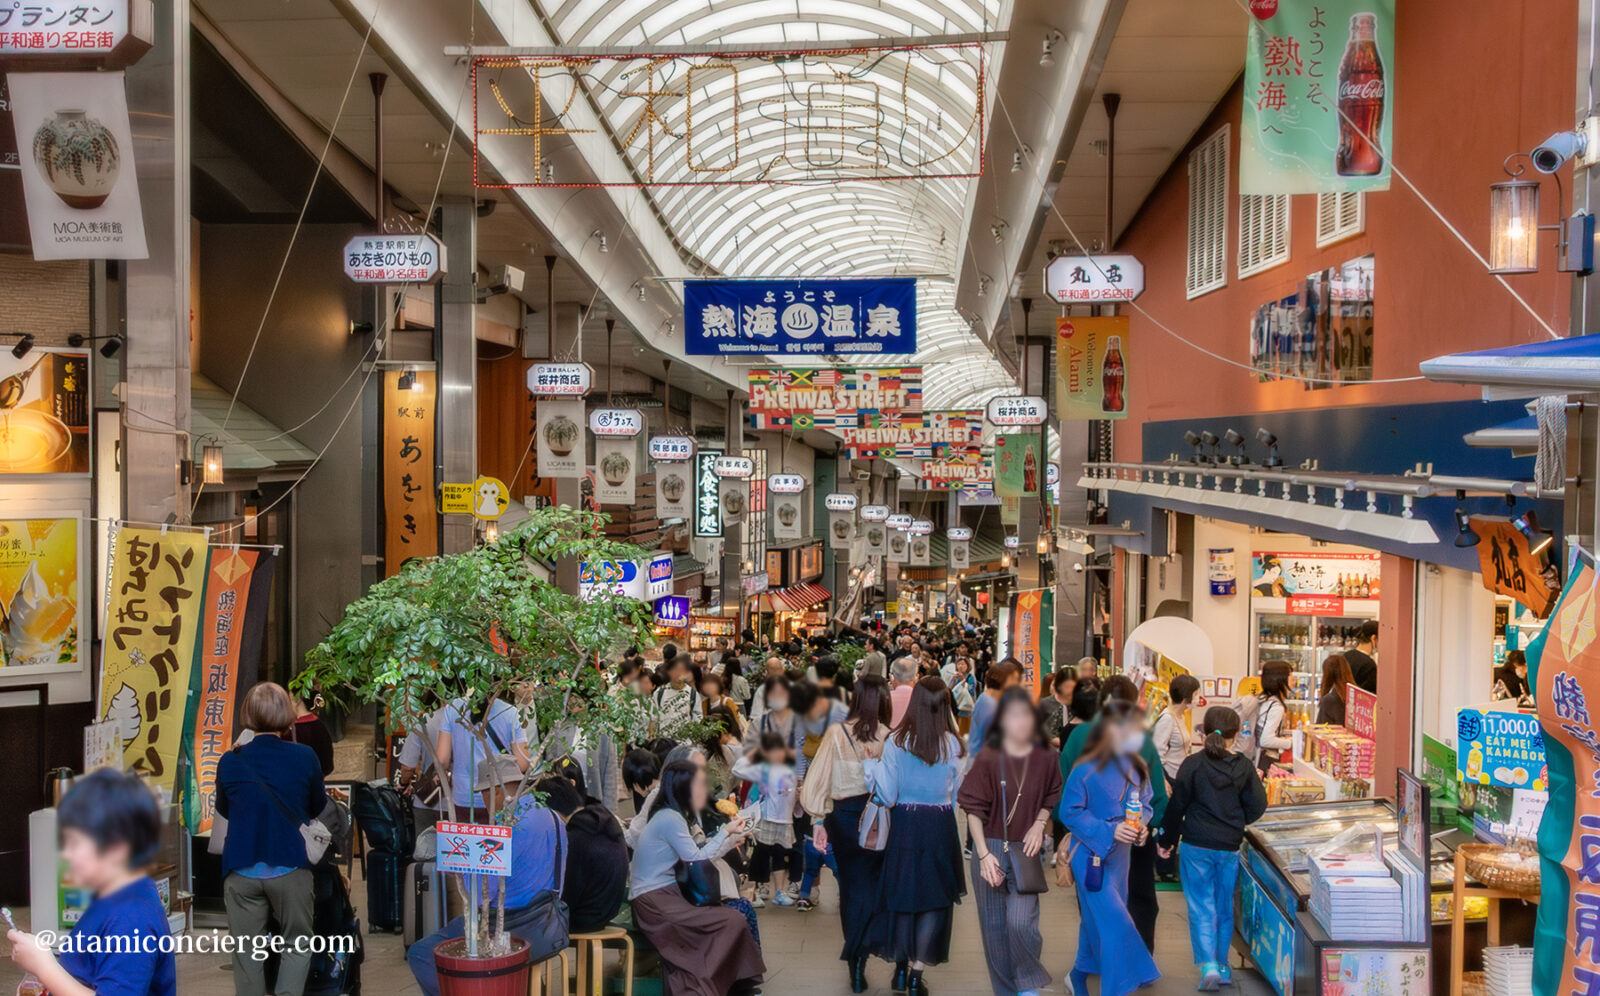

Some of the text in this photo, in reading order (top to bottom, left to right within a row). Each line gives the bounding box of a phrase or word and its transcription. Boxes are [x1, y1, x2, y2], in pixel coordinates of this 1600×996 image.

[0, 1, 114, 26] プランタン
[1340, 79, 1385, 99] Coca-Cola
[53, 221, 122, 235] MOA美術館
[349, 252, 432, 268] あをきのひもの
[354, 269, 428, 280] 平和通り名店街
[763, 290, 836, 303] ようこそ
[538, 374, 580, 385] 桜井商店
[764, 390, 909, 409] HEIWA STREET
[397, 406, 425, 420] 駅前
[856, 427, 972, 444] HEIWA STREET
[932, 466, 977, 479] HEIWA
[399, 434, 422, 544] あをき
[700, 454, 719, 533] お食事処
[1485, 735, 1530, 750] EAT ME!
